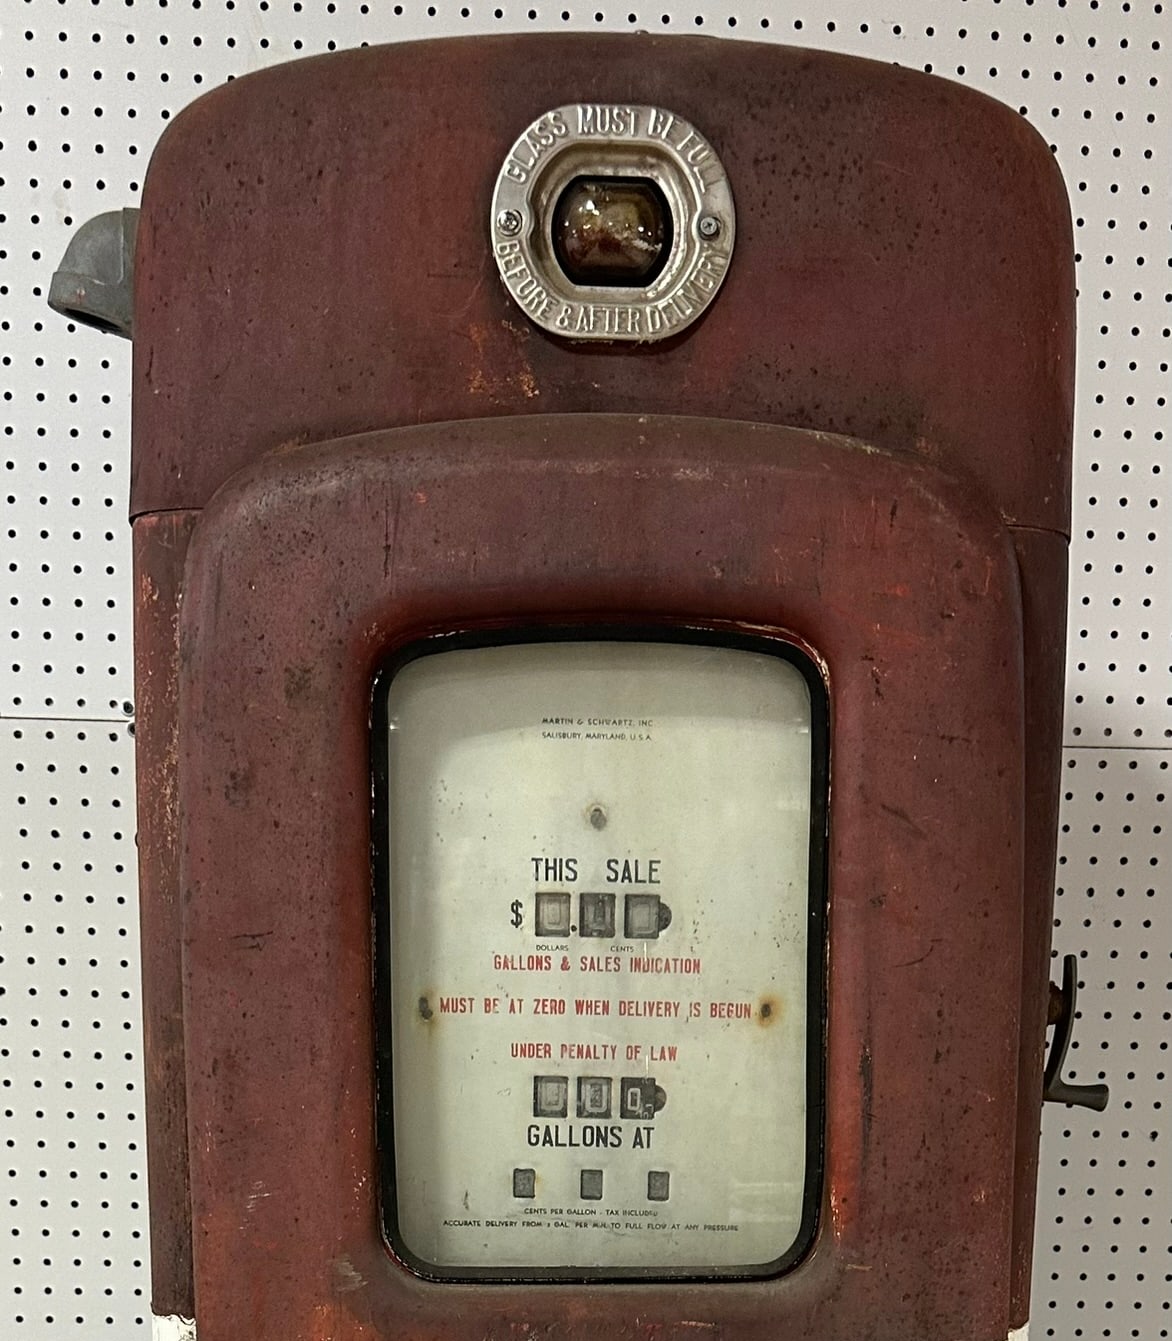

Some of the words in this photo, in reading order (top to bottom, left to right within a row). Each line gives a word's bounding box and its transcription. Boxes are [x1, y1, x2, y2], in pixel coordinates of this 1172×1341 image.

[503, 112, 567, 183] GLASS
[576, 105, 637, 134] MUST
[648, 108, 683, 141] BE
[497, 240, 559, 321] BEFORE
[556, 306, 572, 327] &
[576, 305, 640, 334] AFTER
[531, 857, 578, 882] THIS
[606, 859, 661, 884] SALE
[510, 900, 523, 928] $
[610, 945, 634, 953] CENTS
[494, 954, 552, 971] GALLONS
[560, 956, 571, 972] &
[580, 956, 621, 973] SALES
[630, 957, 701, 974] INDICATION
[440, 997, 475, 1014] MUST
[484, 998, 500, 1014] BE
[509, 998, 524, 1015] AT
[533, 999, 566, 1015] ZERO
[575, 1000, 610, 1016] WHEN
[619, 1000, 681, 1018] DELIVERY
[689, 1002, 701, 1018] IS
[710, 1002, 752, 1019] BEGUN
[511, 1042, 552, 1059] UNDER
[560, 1044, 618, 1061] PENALTY
[626, 1045, 642, 1061] OF
[650, 1046, 678, 1062] LAW
[527, 1124, 623, 1148] GALLONS
[632, 1126, 655, 1149] AT
[485, 1220, 518, 1228] DELIVERY
[575, 1221, 588, 1229] PER
[611, 1222, 621, 1230] TO
[703, 1224, 739, 1232] PRESSURE
